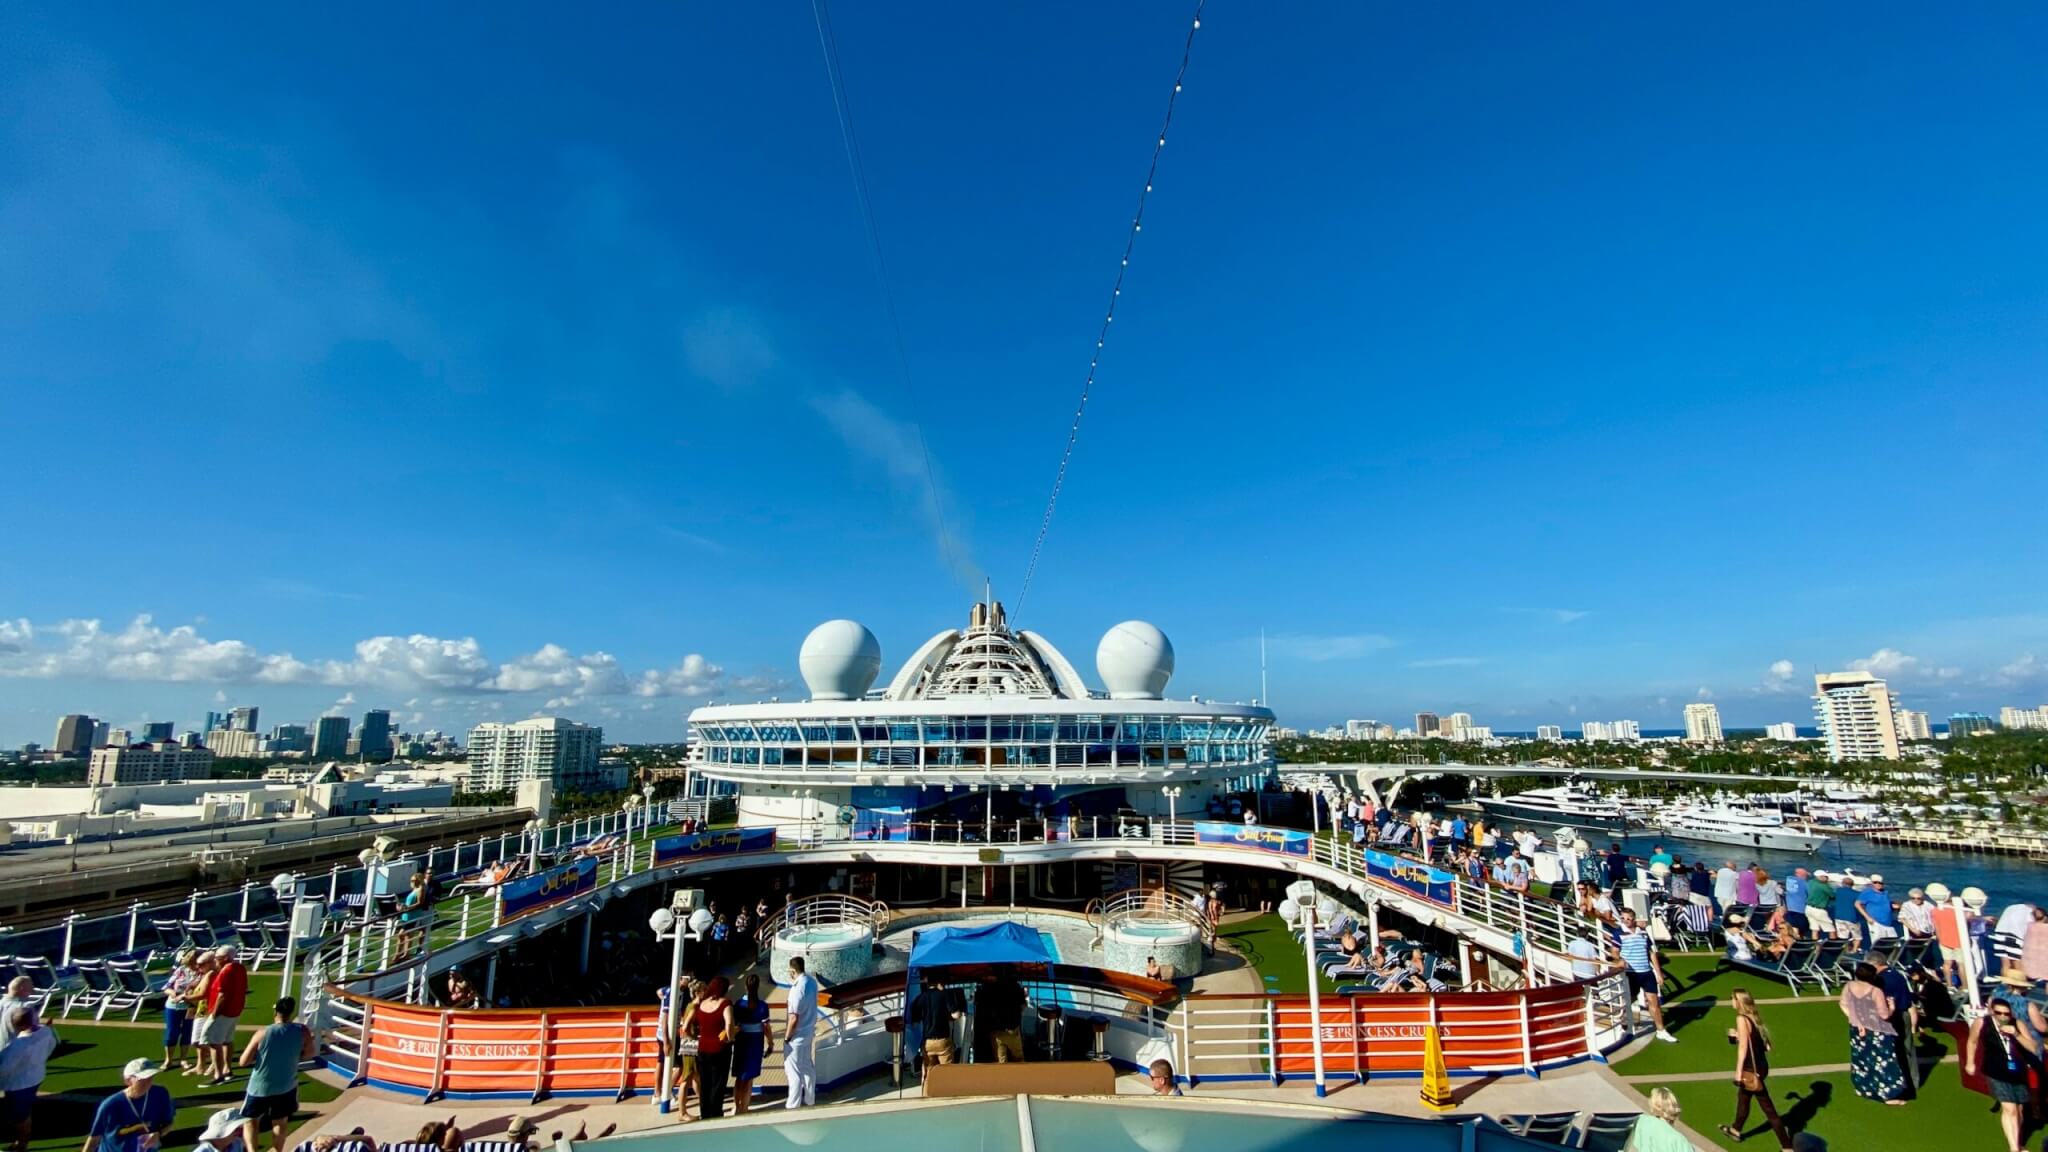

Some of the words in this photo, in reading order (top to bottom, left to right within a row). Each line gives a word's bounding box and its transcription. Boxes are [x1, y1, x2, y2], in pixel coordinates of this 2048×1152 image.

[1337, 1026, 1396, 1037] PRNCESS
[1400, 1025, 1451, 1036] CRUES
[474, 1044, 530, 1056] CRUISES
